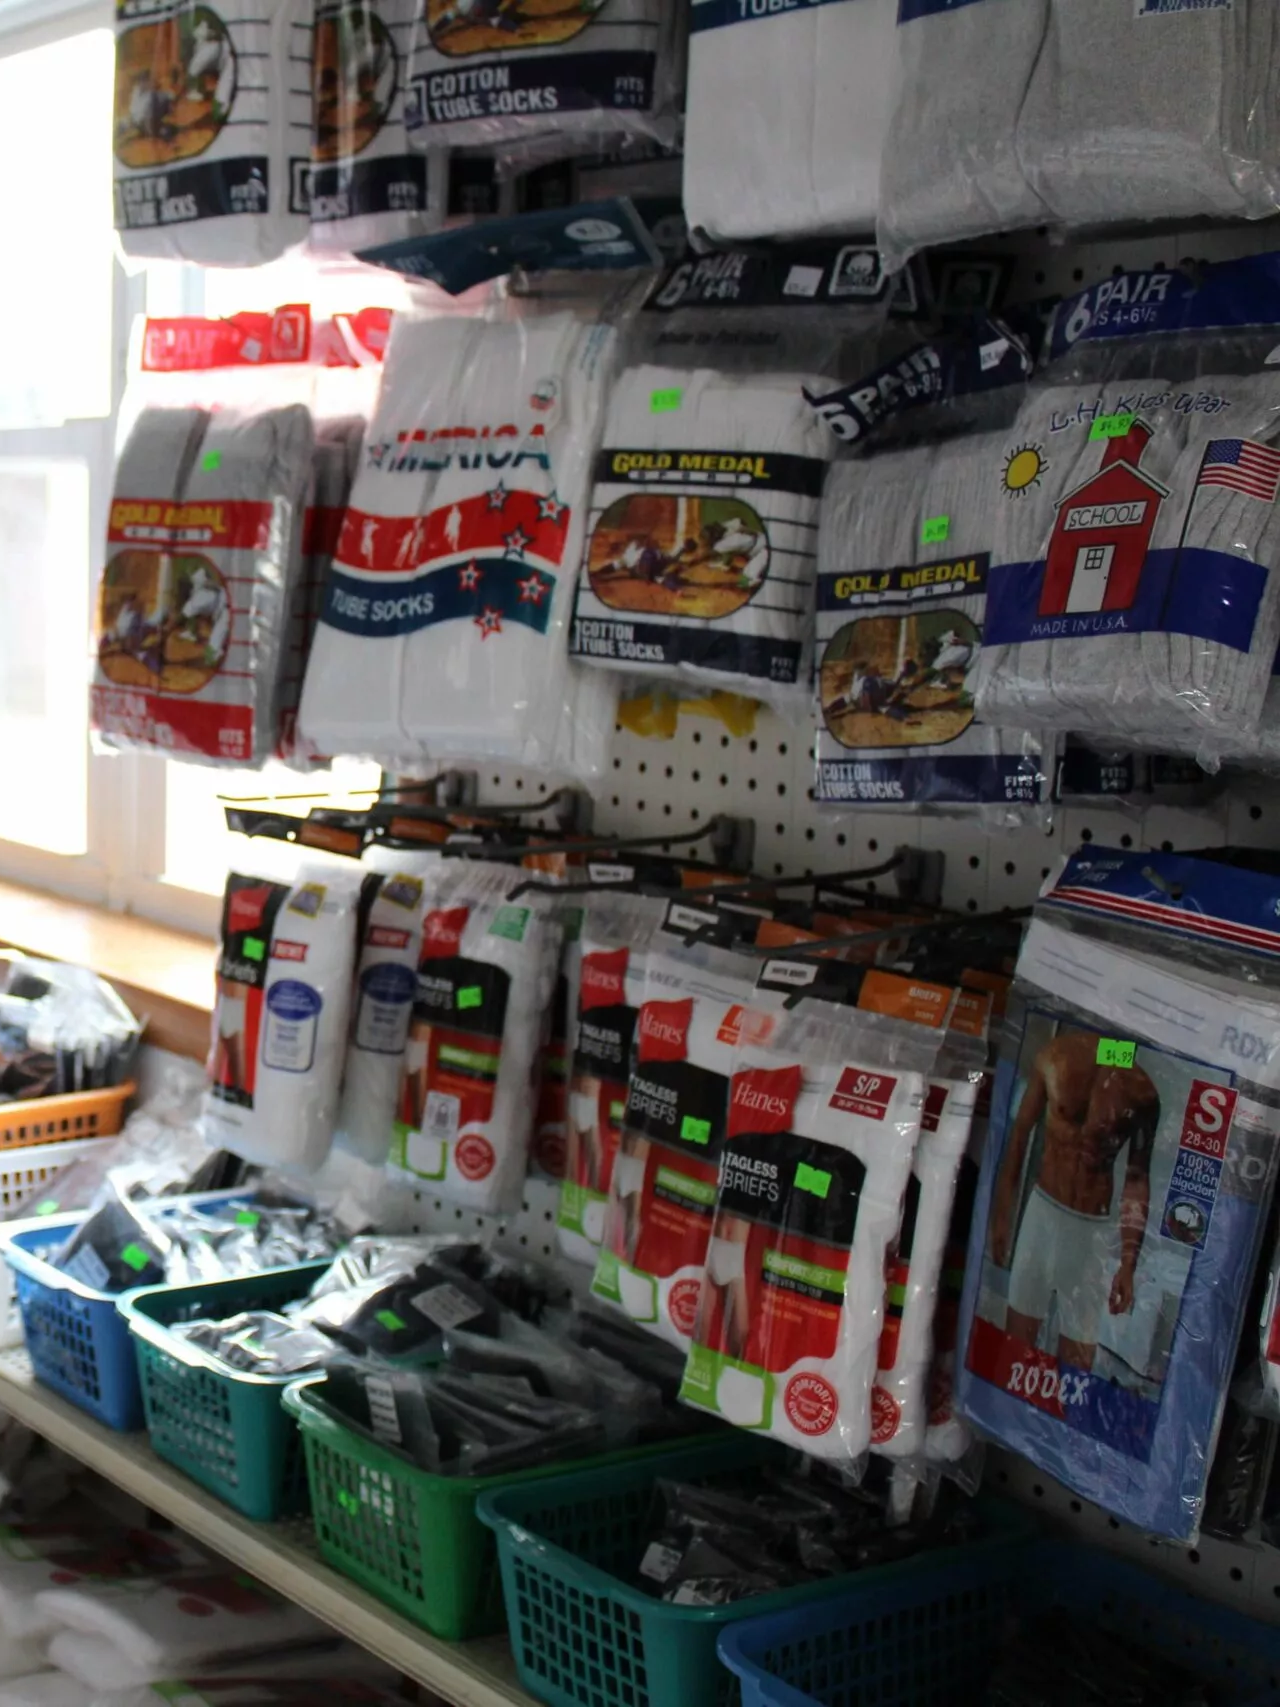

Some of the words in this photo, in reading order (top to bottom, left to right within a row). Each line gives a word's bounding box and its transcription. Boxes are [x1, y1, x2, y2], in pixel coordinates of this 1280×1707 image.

[429, 66, 510, 98] COTTON
[614, 76, 645, 92] FITS
[431, 94, 483, 121] TUBE
[489, 86, 559, 113] SOCKS
[1065, 293, 1092, 343] 6
[1094, 274, 1173, 316] PAIR
[1114, 391, 1171, 417] Kids
[816, 402, 861, 441] 6
[611, 452, 672, 474] GOLD
[678, 453, 771, 479] MEDAL
[1070, 504, 1142, 528] SCHOOL
[330, 593, 368, 620] TUBE
[371, 592, 434, 622] SOCKS
[581, 620, 635, 640] COTTON
[1030, 620, 1067, 636] MADE
[1072, 617, 1090, 632] IN
[582, 636, 616, 653] TUBE
[617, 640, 665, 661] SOCKS
[822, 762, 872, 781] COTTON
[825, 780, 857, 799] TUBE
[858, 780, 905, 799] SOCKS
[632, 1077, 679, 1105] TAGLESS
[852, 1073, 881, 1098] S/P
[629, 1092, 678, 1126] BRIEFS
[733, 1081, 789, 1117] Hanes
[1194, 1088, 1228, 1134] S
[1184, 1130, 1221, 1154] 28-30
[724, 1151, 779, 1180] TAGLESS
[1175, 1164, 1220, 1187] cotton
[1181, 1152, 1216, 1176] 100%
[722, 1168, 781, 1203] BRIEFS
[1171, 1175, 1218, 1199] algodon
[790, 1378, 833, 1404] COMFORT
[1006, 1361, 1090, 1407] RODEX
